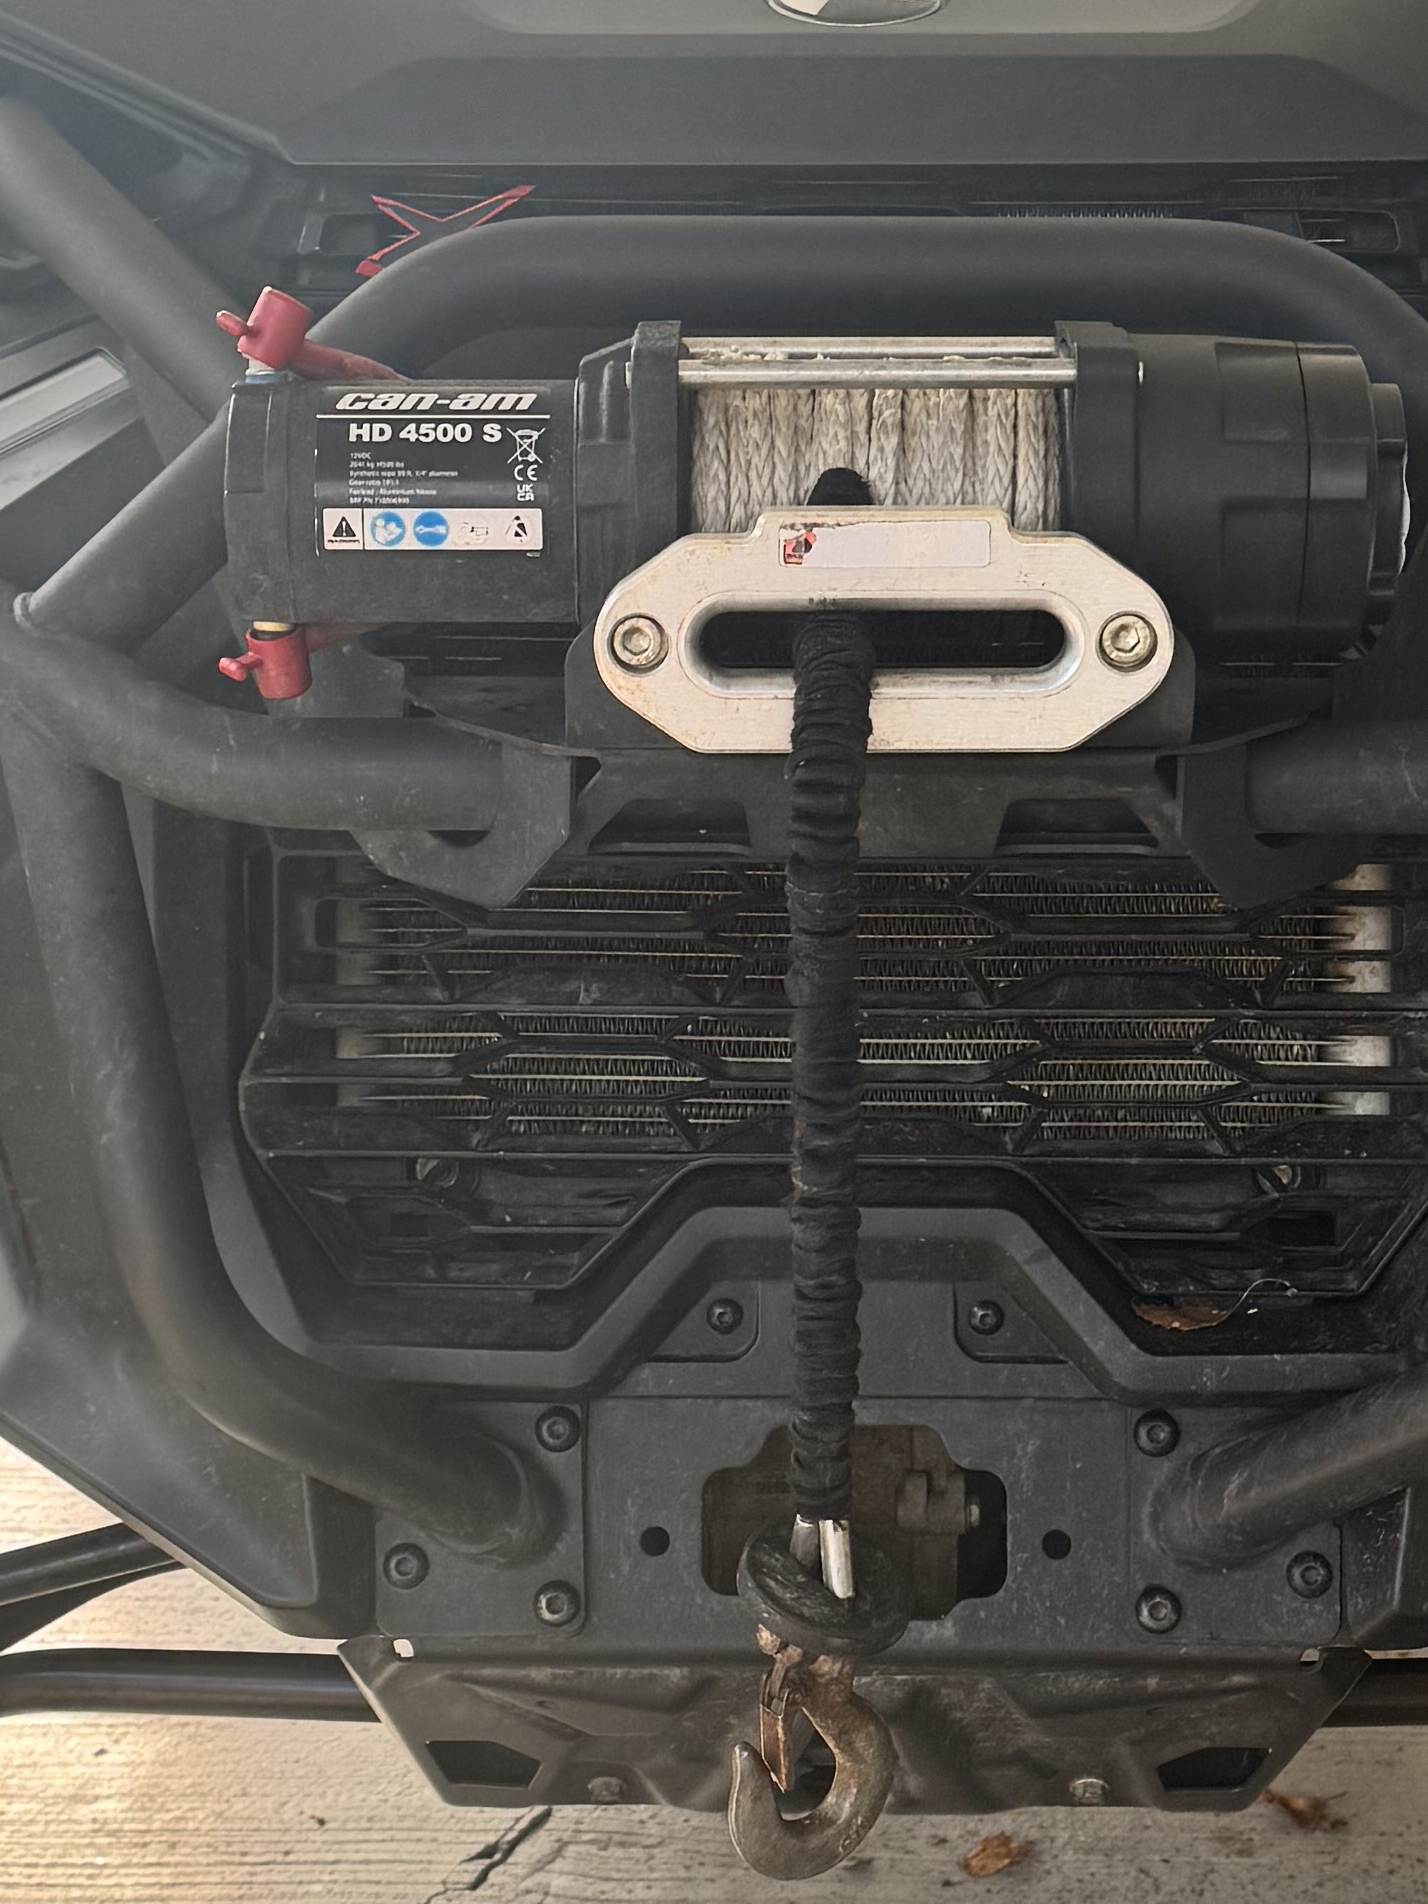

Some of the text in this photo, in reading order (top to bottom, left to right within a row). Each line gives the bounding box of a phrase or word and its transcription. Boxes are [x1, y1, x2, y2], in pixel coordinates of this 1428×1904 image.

[335, 392, 538, 411] can-am
[348, 422, 503, 443] HD 4500 S
[513, 465, 538, 481] CE
